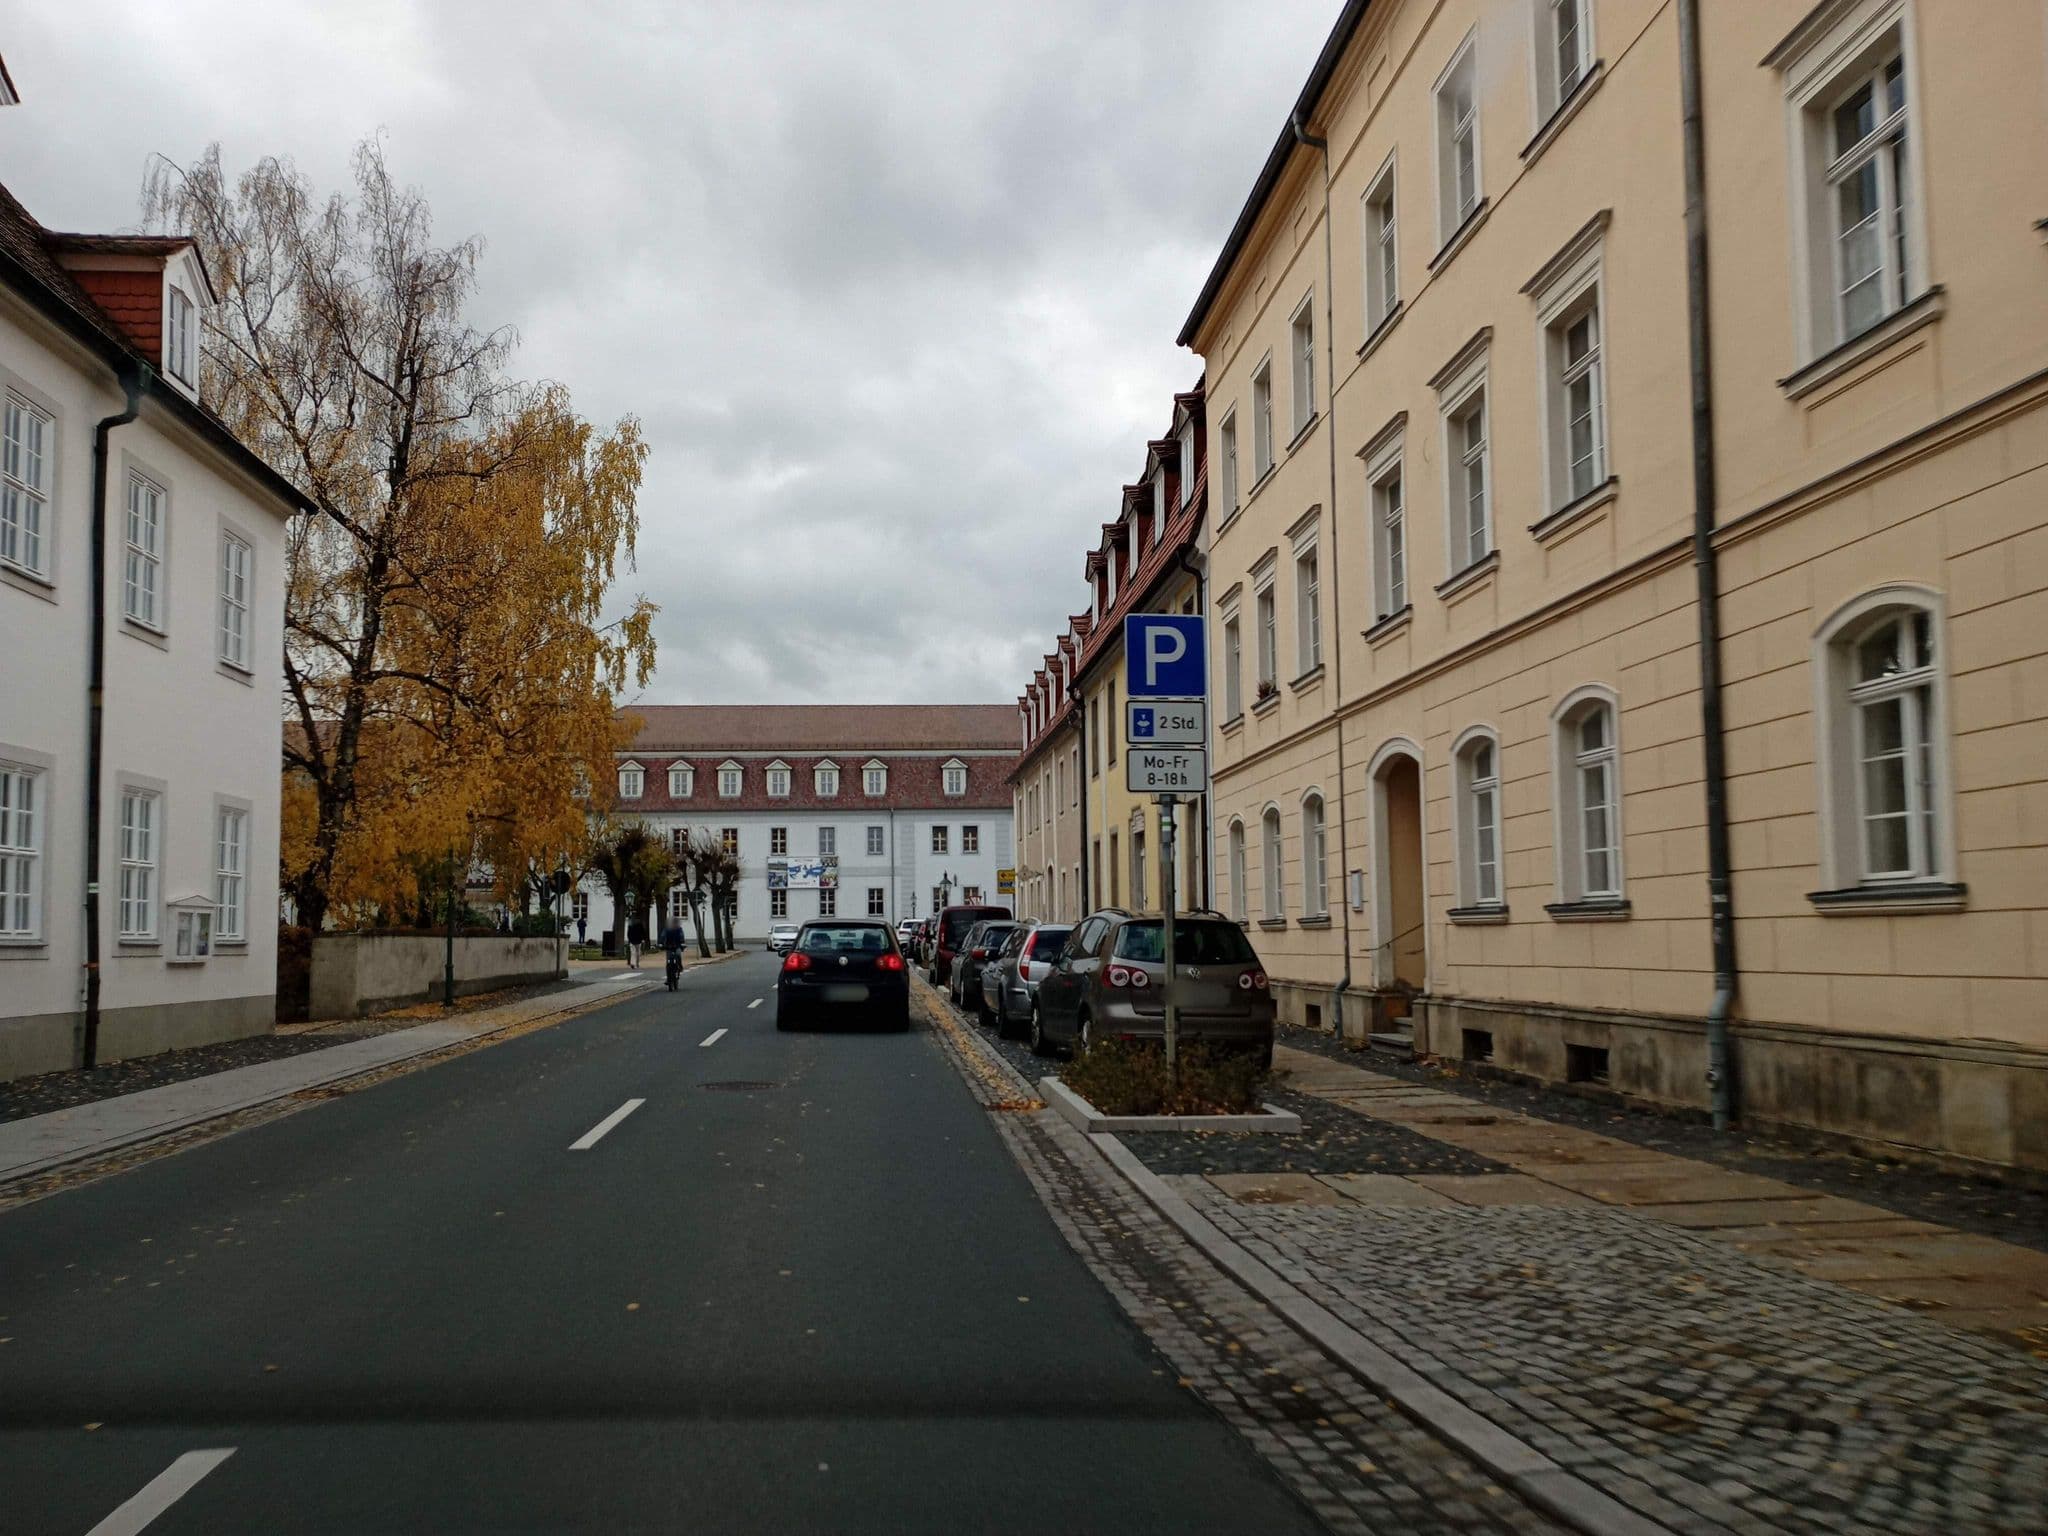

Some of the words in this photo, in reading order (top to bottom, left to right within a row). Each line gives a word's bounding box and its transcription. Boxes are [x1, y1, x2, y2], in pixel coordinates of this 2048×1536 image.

[1145, 626, 1187, 686] P
[1159, 716, 1168, 730] 2
[1171, 716, 1199, 730] Std.
[1144, 755, 1189, 769] Mo-Fr
[1147, 772, 1178, 786] 8-18
[1180, 772, 1188, 785] h
